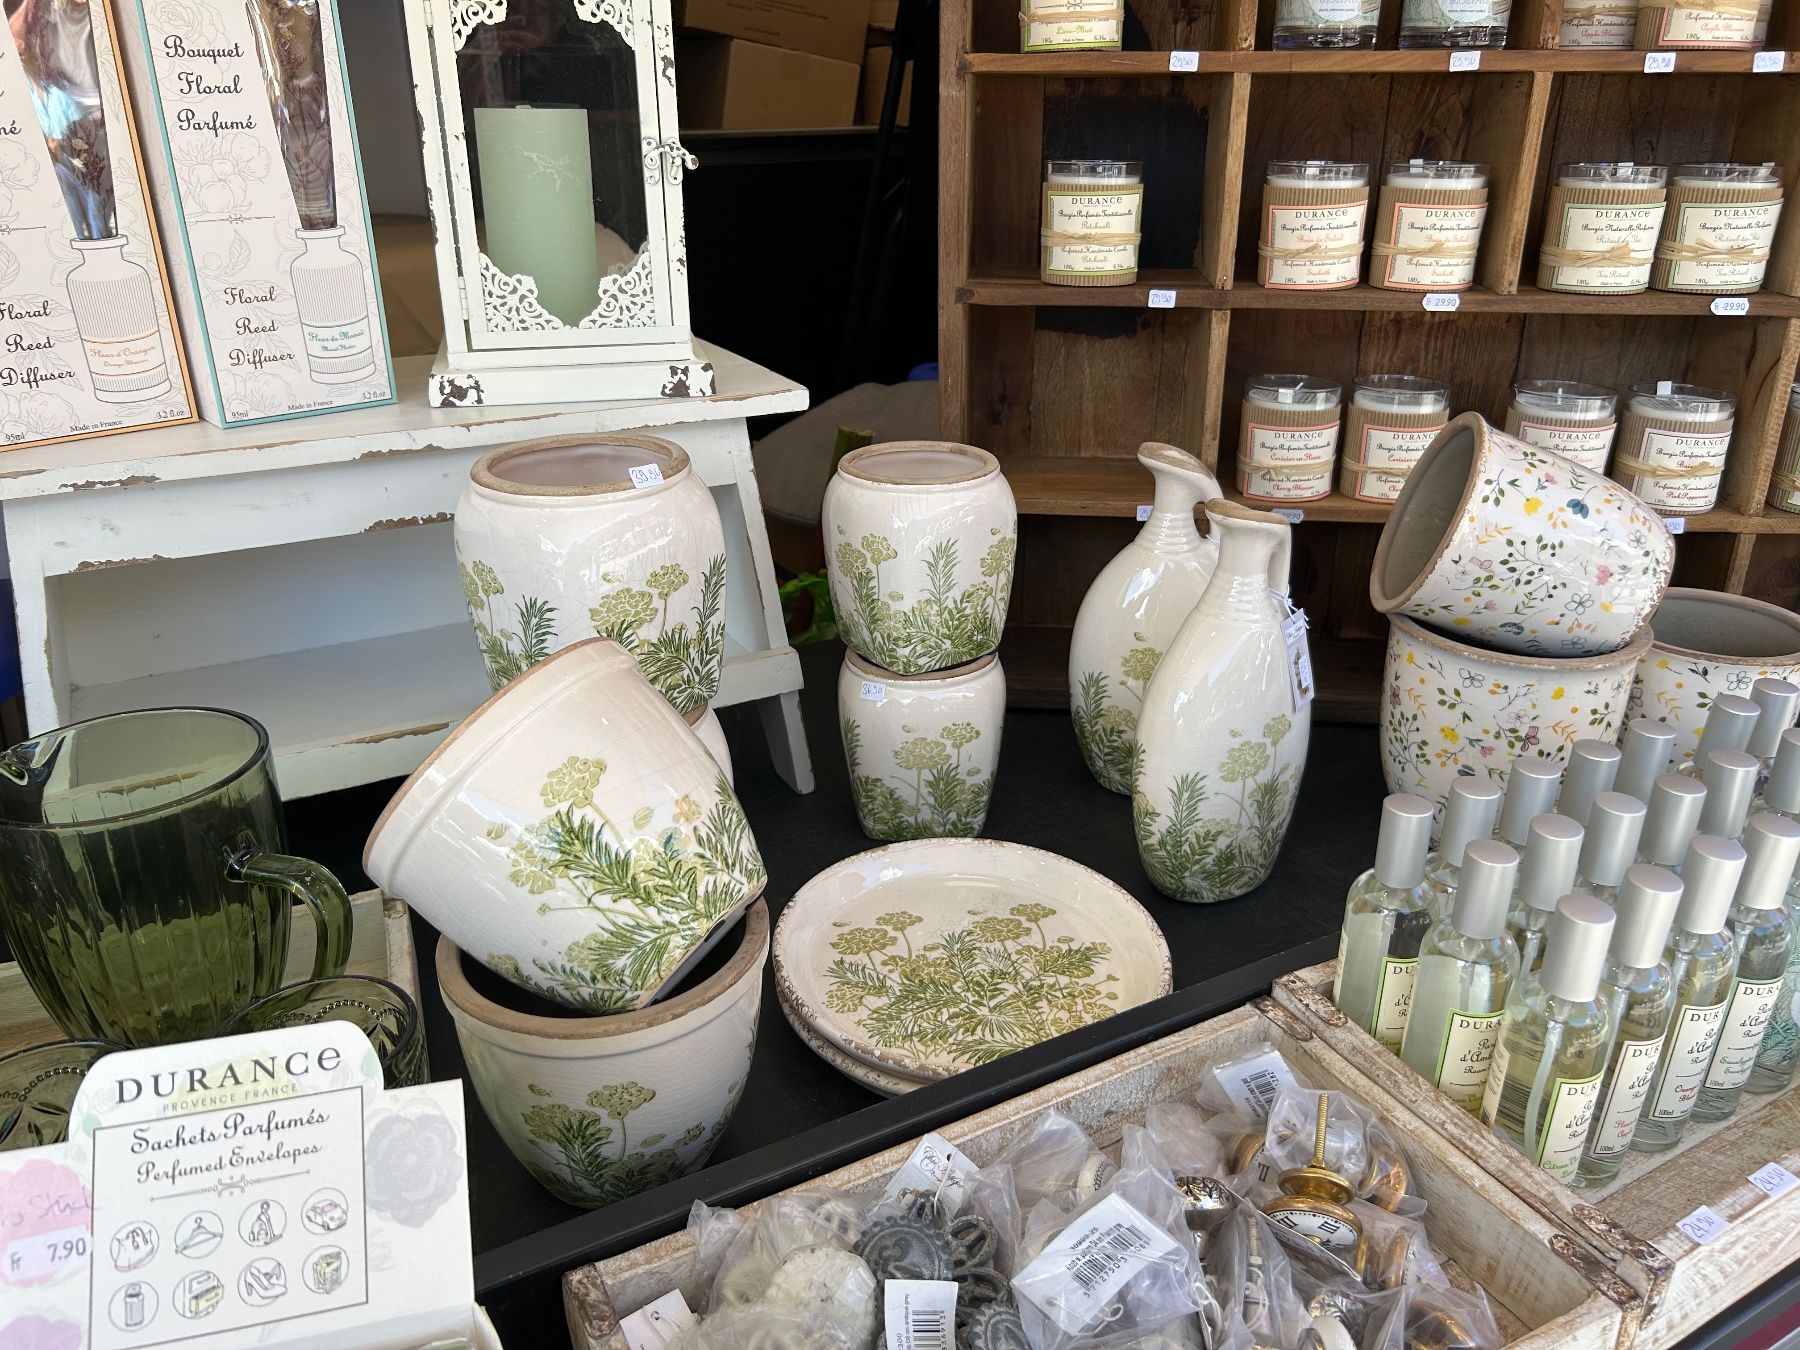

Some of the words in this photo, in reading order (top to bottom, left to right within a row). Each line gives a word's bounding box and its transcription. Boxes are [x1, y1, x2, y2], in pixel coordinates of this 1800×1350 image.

[163, 34, 244, 64] Bouquet
[177, 71, 243, 95] Floral
[177, 108, 257, 137] Parfumé
[224, 286, 278, 306] Floral
[235, 317, 279, 336] Reed
[5, 333, 55, 353] Reed
[228, 348, 296, 371] Diffuser
[0, 366, 76, 389] Diffuser
[163, 1094, 236, 1113] PROVENCE
[245, 1083, 298, 1099] FRANCE
[130, 1127, 222, 1154] Sachets
[223, 1109, 331, 1141] Parfumés
[137, 1157, 227, 1186] Perfumed
[228, 1140, 323, 1169] Envelopes
[47, 1237, 87, 1262] 7.90
